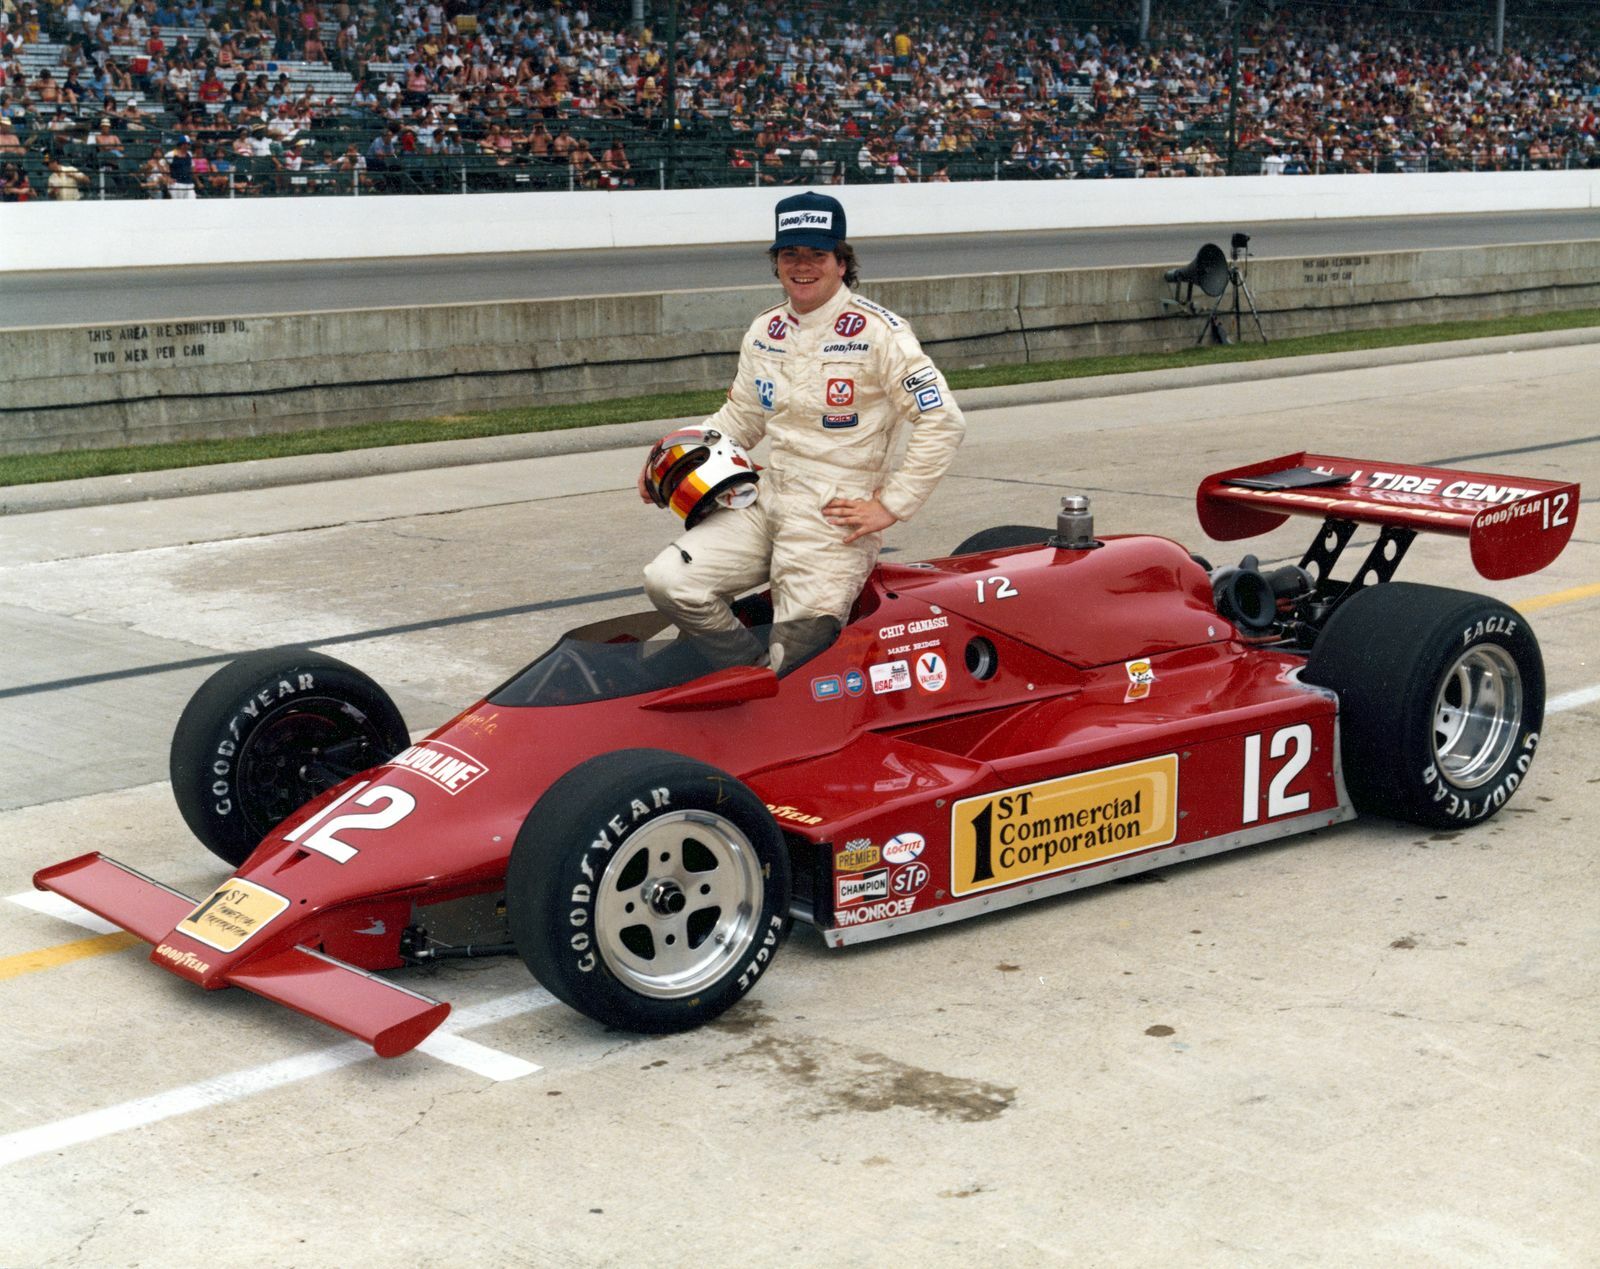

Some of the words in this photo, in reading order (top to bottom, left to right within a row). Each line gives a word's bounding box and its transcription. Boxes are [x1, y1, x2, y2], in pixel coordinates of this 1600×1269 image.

[88, 329, 113, 342] THIS
[119, 326, 148, 340] AREA
[835, 313, 864, 335] STP
[94, 352, 115, 364] TWO
[125, 347, 149, 362] MEN
[156, 346, 176, 359] PER
[183, 344, 206, 357] CAR
[1369, 472, 1442, 495] TIRE
[1476, 500, 1541, 528] GOODYEAR
[1543, 493, 1569, 530] 12
[975, 576, 1018, 603] 12
[879, 624, 905, 639] CHIP
[907, 616, 948, 634] GANASSI
[1463, 616, 1517, 646] EAGLE
[888, 645, 911, 655] MARK
[874, 679, 893, 691] USAC
[212, 672, 314, 815] GOODYEAR
[1242, 723, 1312, 825] 12
[1422, 732, 1539, 819] GOODYEAR
[282, 781, 416, 864] 12
[1000, 790, 1141, 846] Commercial
[839, 850, 879, 866] PREMIER
[886, 841, 922, 856] LOCTITE
[1000, 819, 1141, 870] Corporation
[570, 787, 671, 973] GOODYEAR
[840, 879, 886, 896] CHAMPION
[894, 866, 927, 892] STP
[843, 898, 910, 926] MONROE
[156, 944, 210, 974] GOODYEAR
[737, 915, 782, 992] EAGLE
